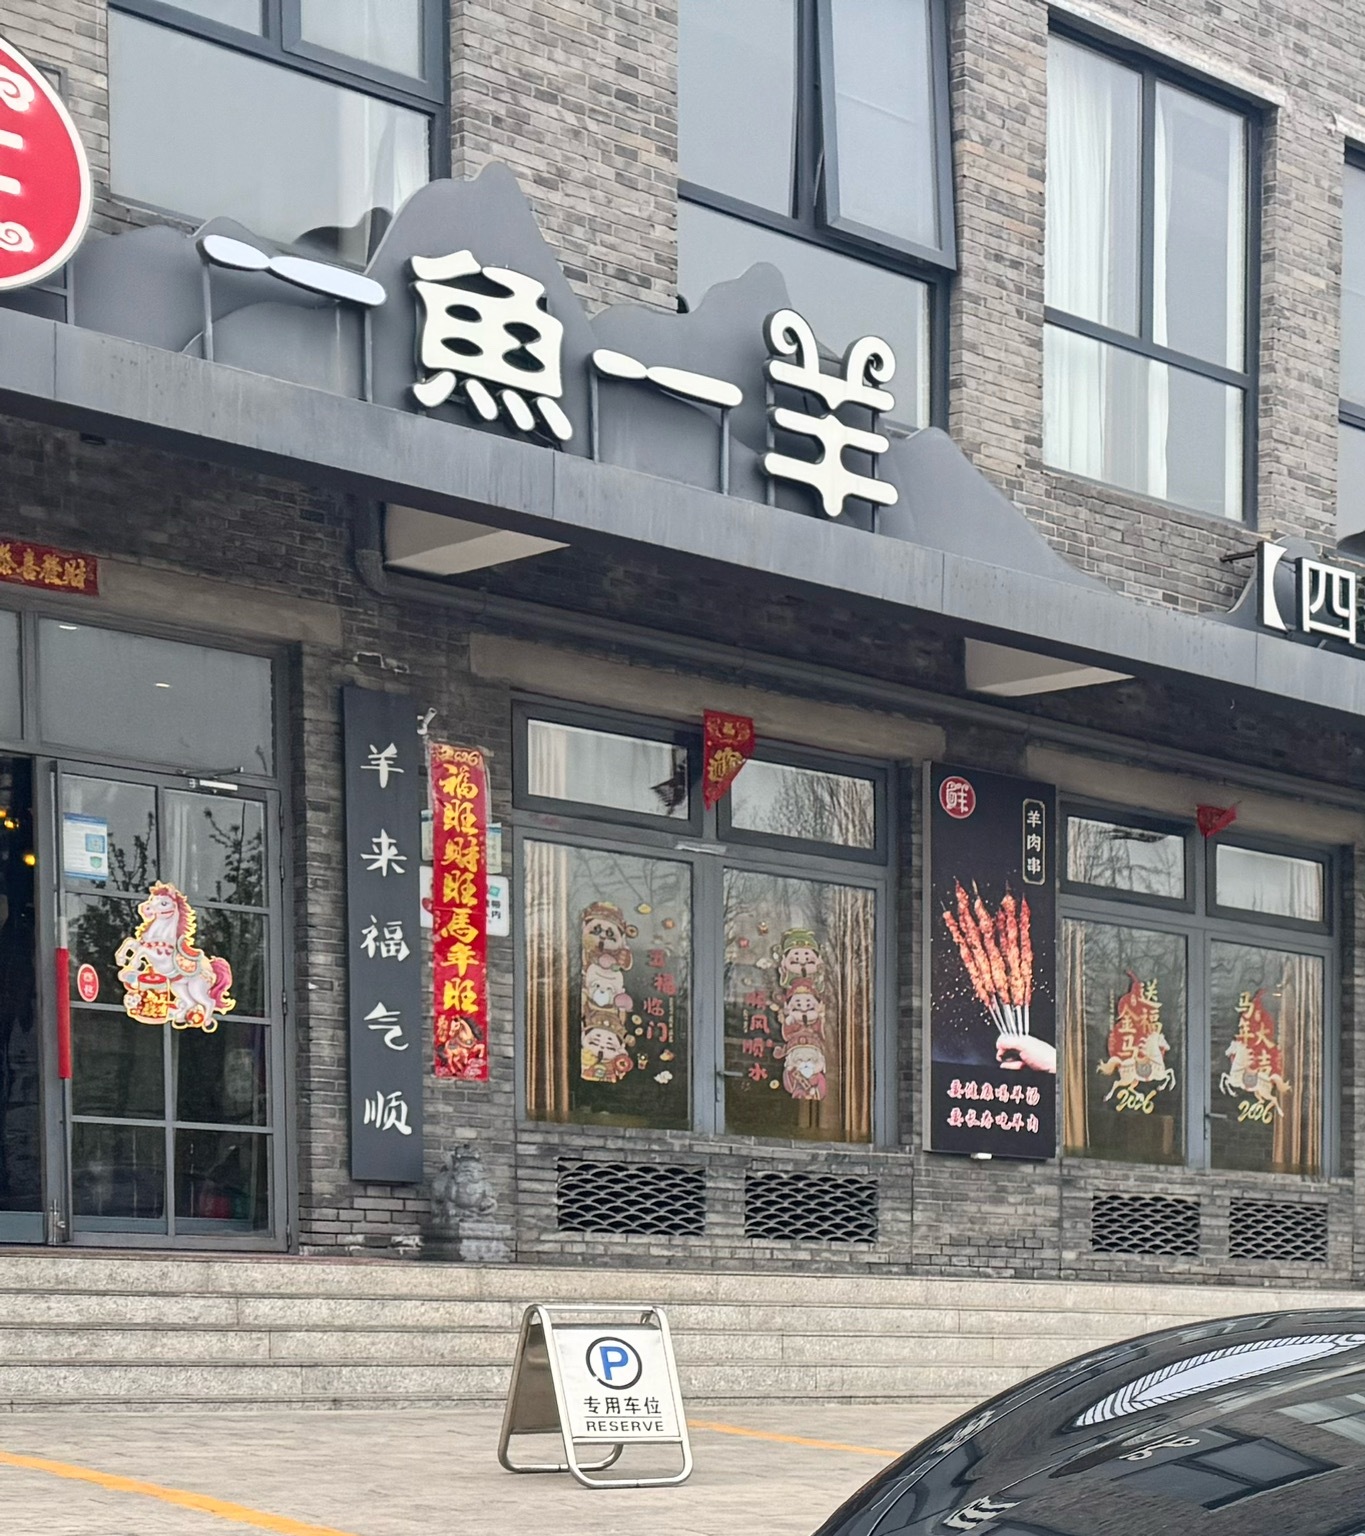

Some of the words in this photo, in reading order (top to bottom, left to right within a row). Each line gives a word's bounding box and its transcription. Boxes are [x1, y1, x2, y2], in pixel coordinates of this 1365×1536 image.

[1026, 809, 1042, 875] 羊肉串
[360, 742, 413, 1137] 羊来福气顺
[1116, 1089, 1157, 1115] 2026
[1237, 1099, 1273, 1124] 2026
[599, 1346, 629, 1381] P
[583, 1396, 662, 1415] 专用车位
[586, 1420, 664, 1432] RESERVE
